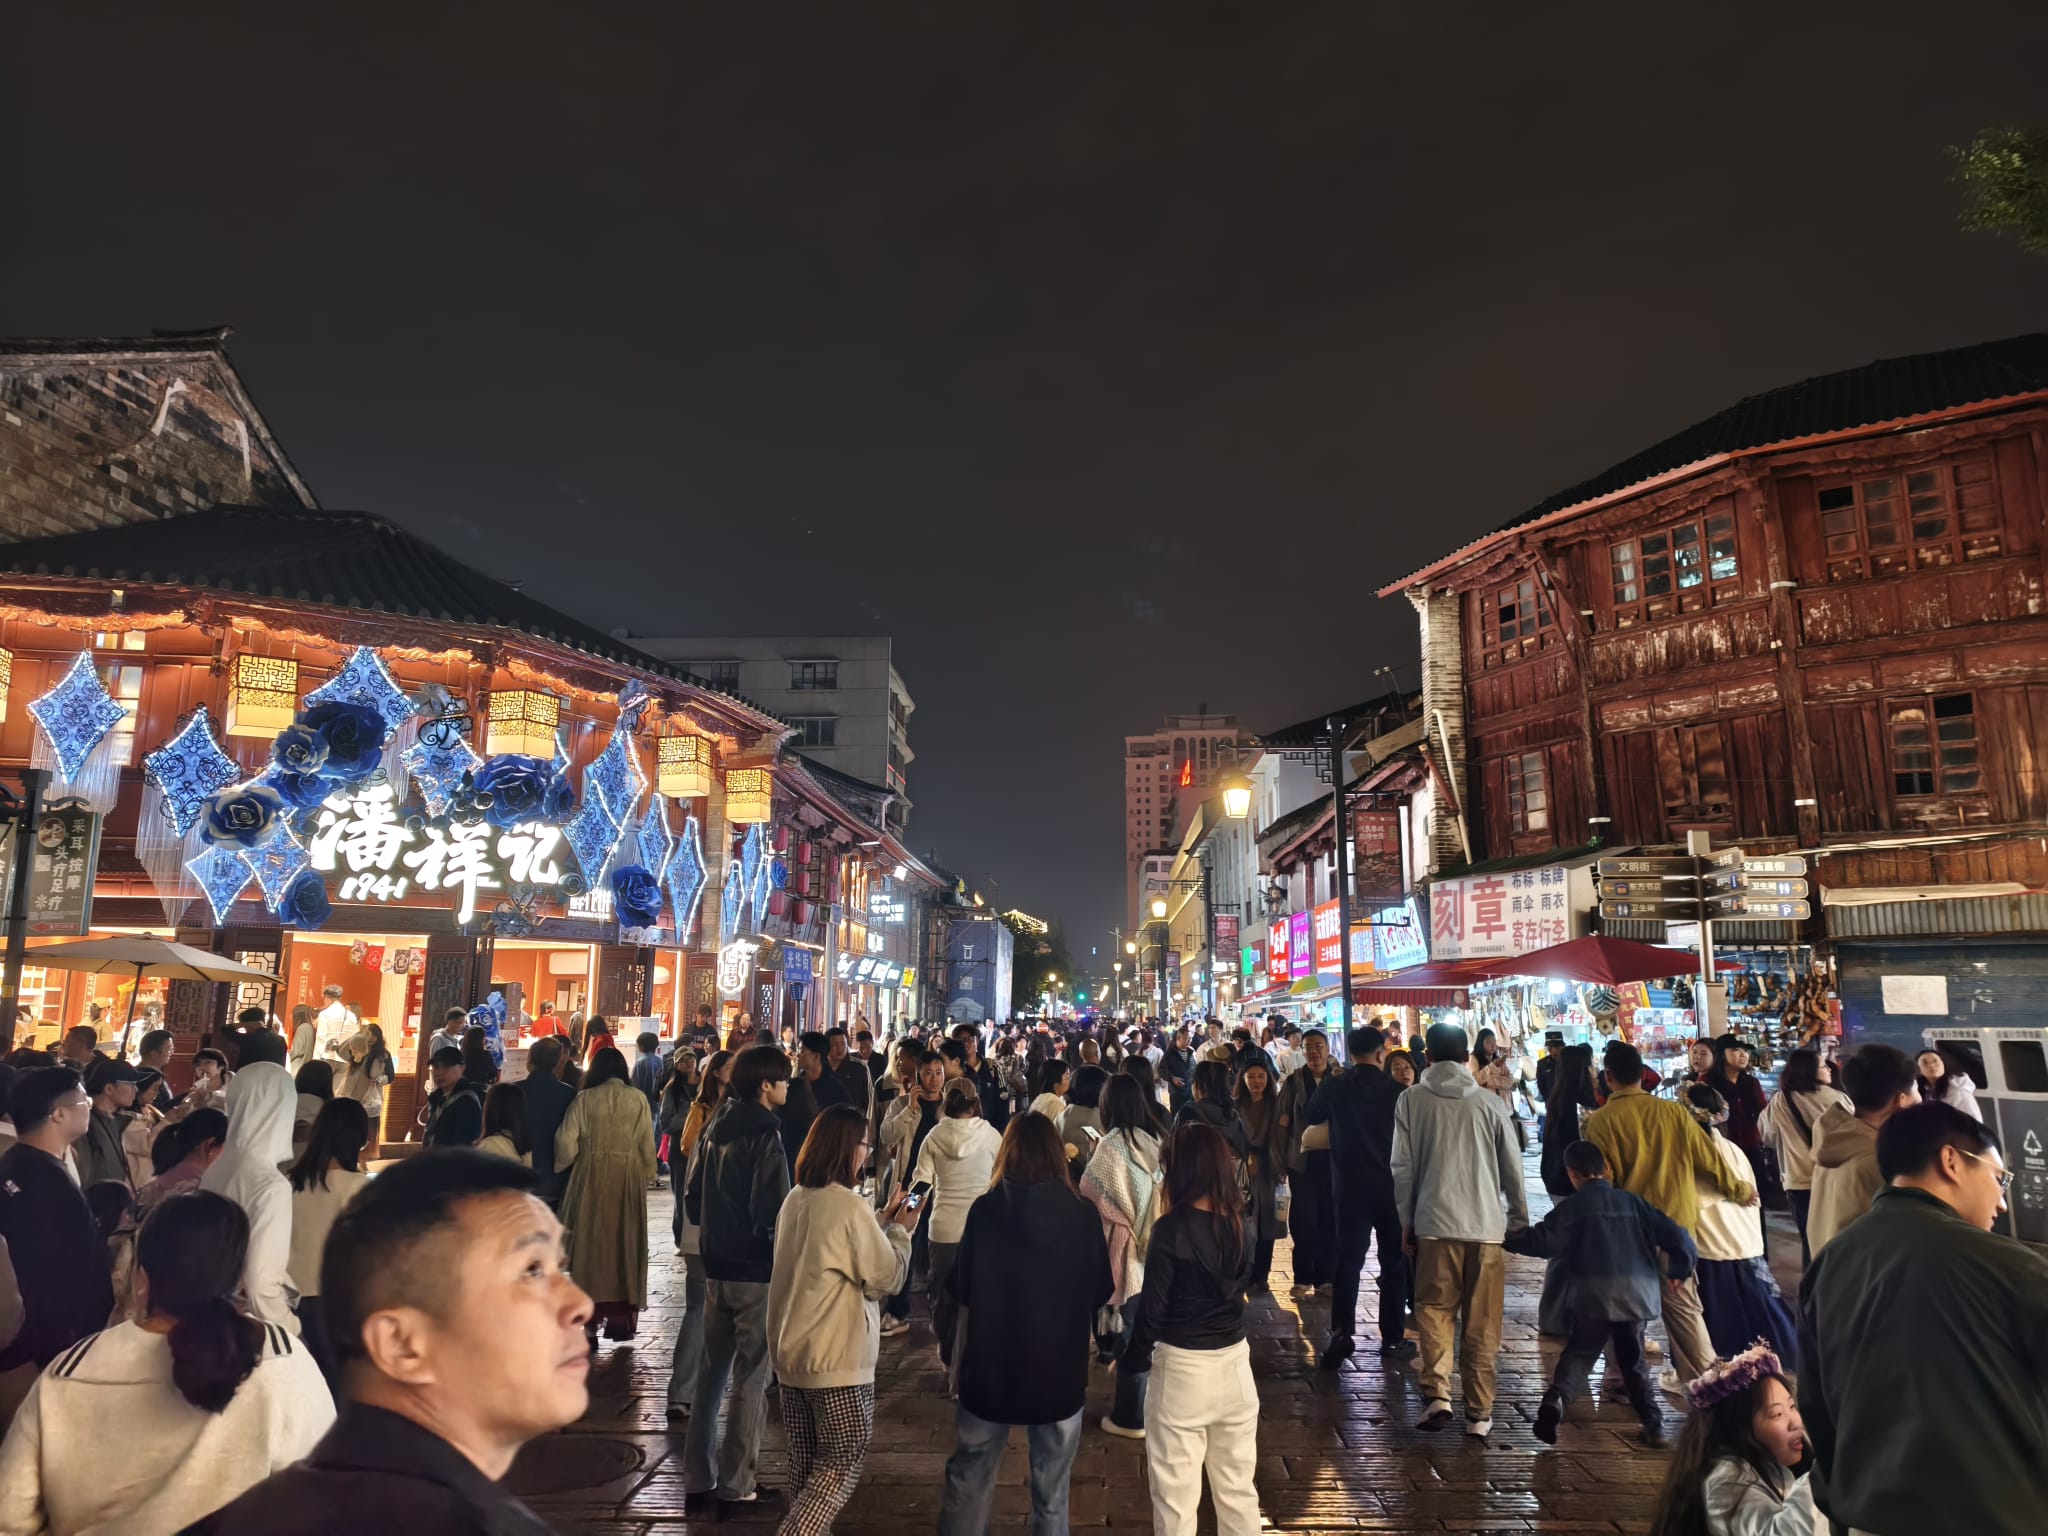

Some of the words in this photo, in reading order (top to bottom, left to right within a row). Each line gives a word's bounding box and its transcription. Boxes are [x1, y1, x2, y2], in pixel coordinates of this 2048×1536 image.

[310, 784, 560, 924] 潘祥记
[1618, 861, 1650, 873] 文明街
[1743, 861, 1786, 872] 文庙直街
[48, 845, 69, 911] 头疗足疗
[340, 872, 409, 901] 1941
[1512, 872, 1534, 890] 布标
[1540, 868, 1564, 888] 标牌
[1629, 883, 1662, 891] 东方书店
[1751, 882, 1777, 890] 卫生间
[1433, 875, 1507, 942] 刻章
[1512, 895, 1534, 913] 雨伞
[1540, 892, 1564, 911] 雨衣
[1631, 904, 1656, 913] 卫生间
[1512, 916, 1565, 950] 寄存行李
